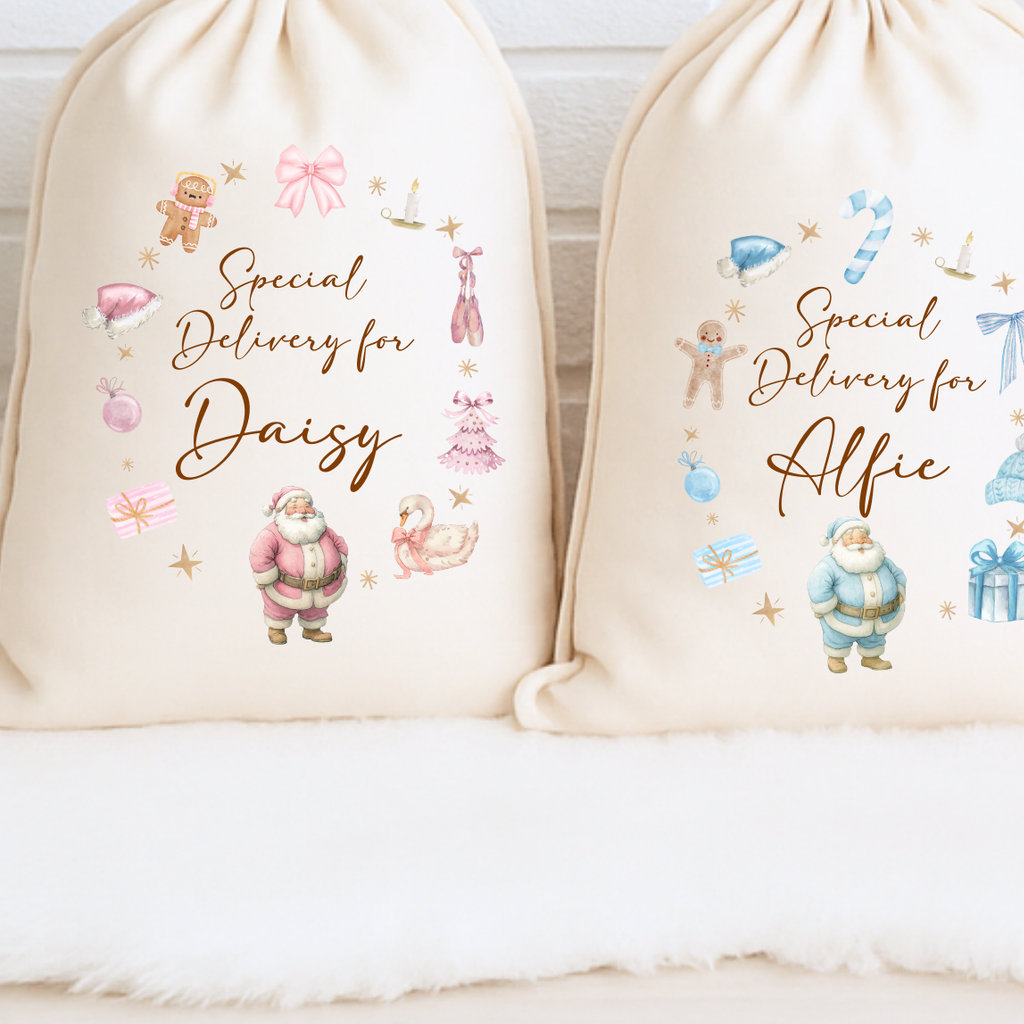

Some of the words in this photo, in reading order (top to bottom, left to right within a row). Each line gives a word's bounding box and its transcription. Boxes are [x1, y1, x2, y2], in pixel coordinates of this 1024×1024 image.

[219, 247, 367, 311] Special
[172, 309, 351, 374] Delivery
[356, 318, 414, 373] for
[796, 286, 941, 349] Special
[748, 347, 924, 413] Delivery
[929, 359, 986, 412] for
[175, 377, 402, 492] Daisy
[767, 416, 950, 518] Alfie
